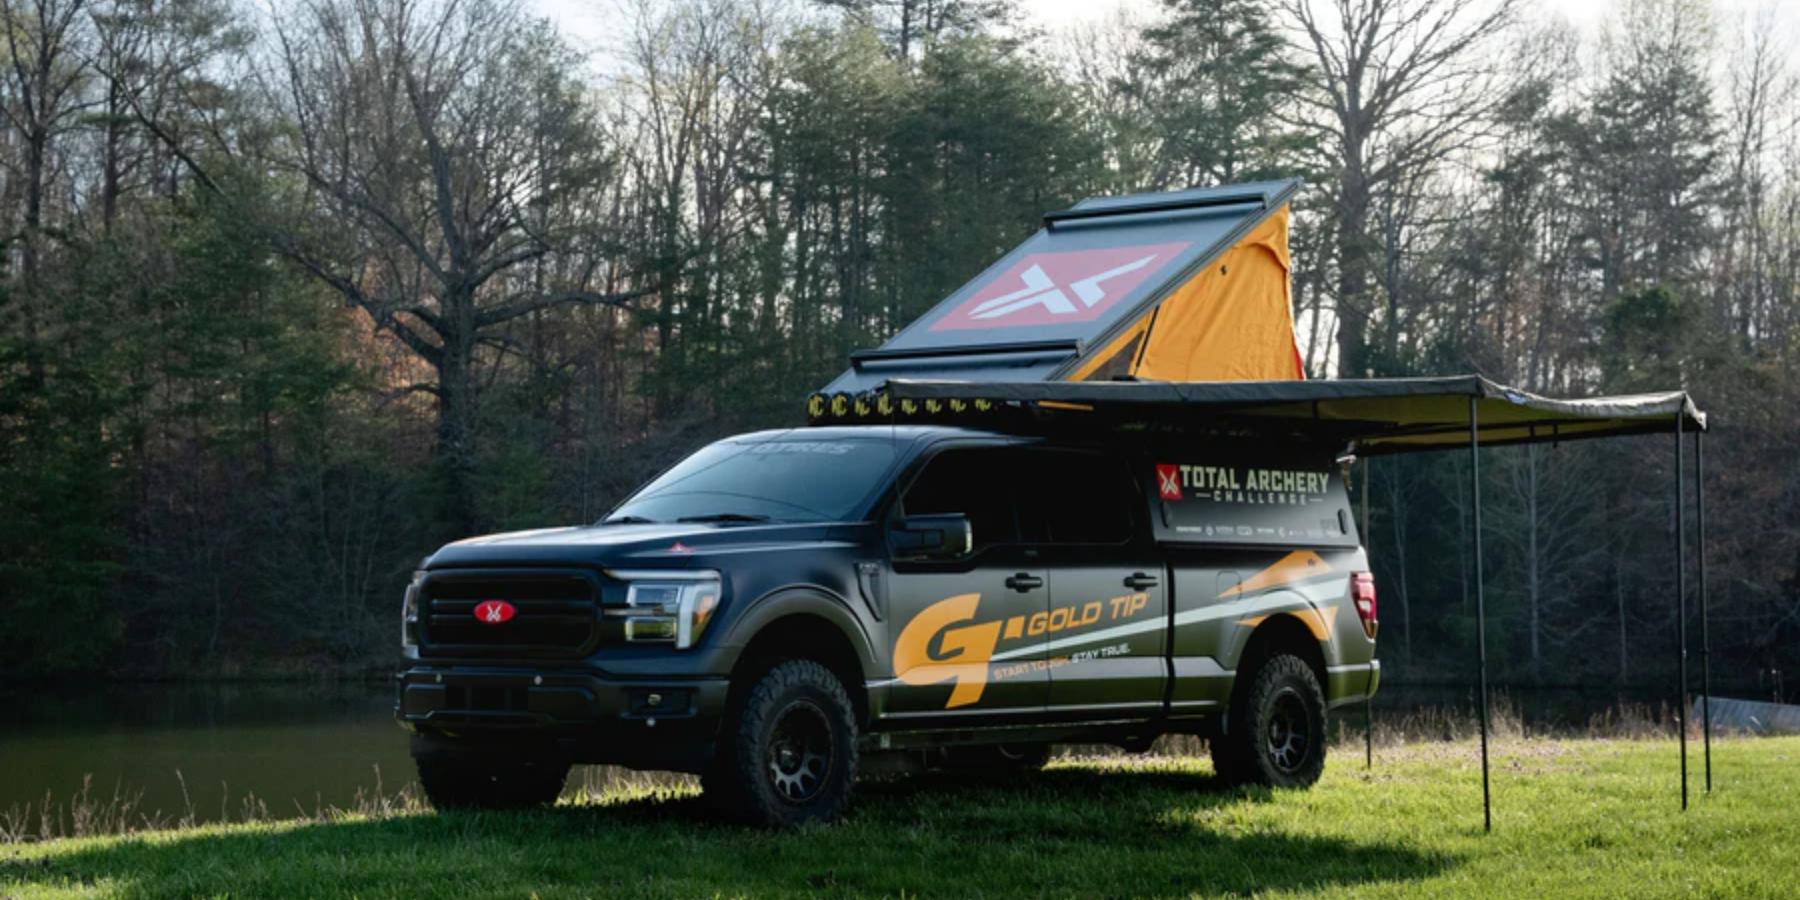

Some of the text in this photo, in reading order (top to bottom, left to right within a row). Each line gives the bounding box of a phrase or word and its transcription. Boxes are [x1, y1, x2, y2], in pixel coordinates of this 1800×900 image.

[1179, 464, 1329, 494] TOTAL ARCHERY
[1213, 490, 1307, 506] CHALLENGE
[1027, 592, 1148, 636] GOLD TIP
[993, 664, 1030, 680] START
[1071, 649, 1099, 664] STAY
